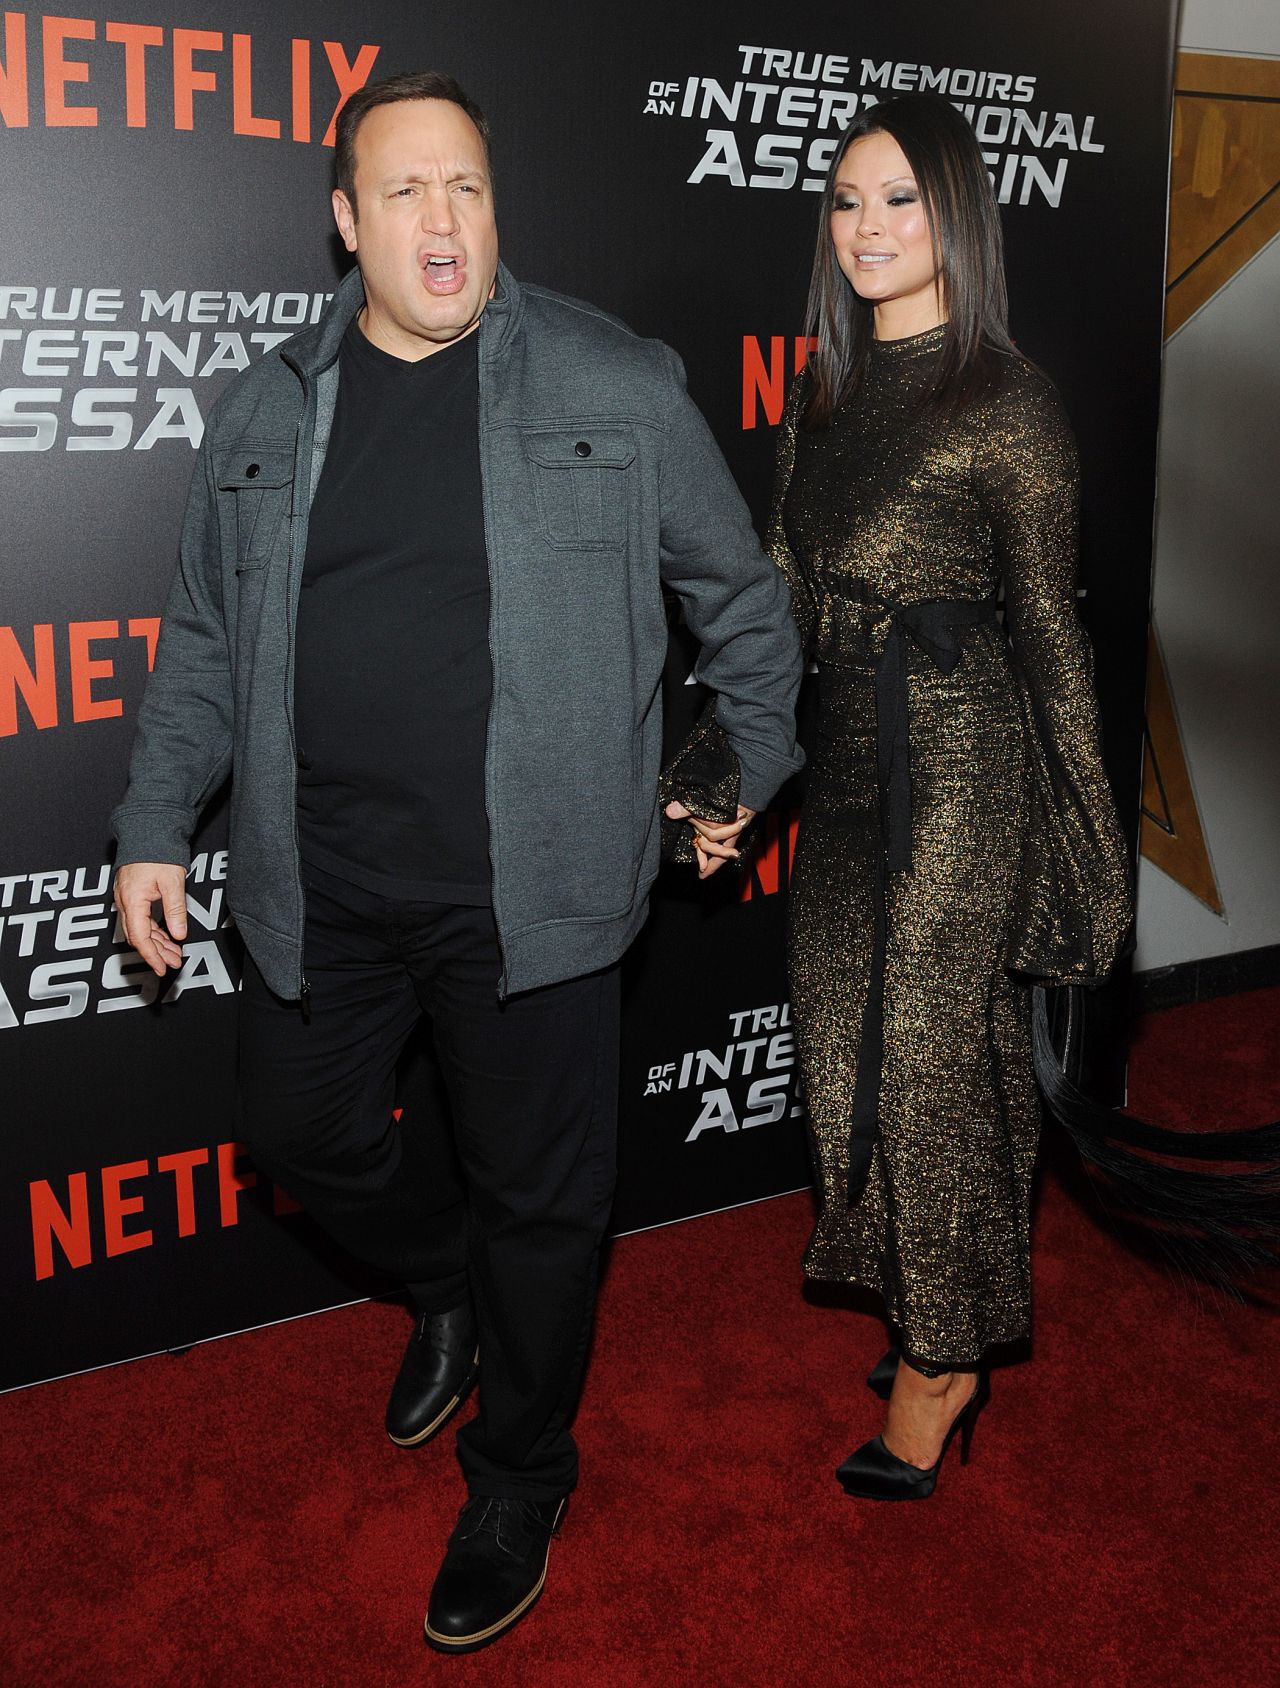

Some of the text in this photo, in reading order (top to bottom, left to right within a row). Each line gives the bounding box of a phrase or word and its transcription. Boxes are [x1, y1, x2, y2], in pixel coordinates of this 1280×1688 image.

[648, 80, 680, 97] OF
[738, 44, 1037, 103] TRUE MEMOIRS
[643, 99, 675, 116] AN
[680, 76, 1105, 154] INTERONAL
[686, 129, 1069, 209] ASSIN
[140, 289, 334, 324] MEMOI
[0, 329, 294, 377] ERNA
[0, 940, 242, 1029] SSA
[643, 1078, 673, 1096] AN
[648, 1062, 677, 1080] OF
[684, 1073, 803, 1142] AS
[29, 1141, 304, 1281] NETF
